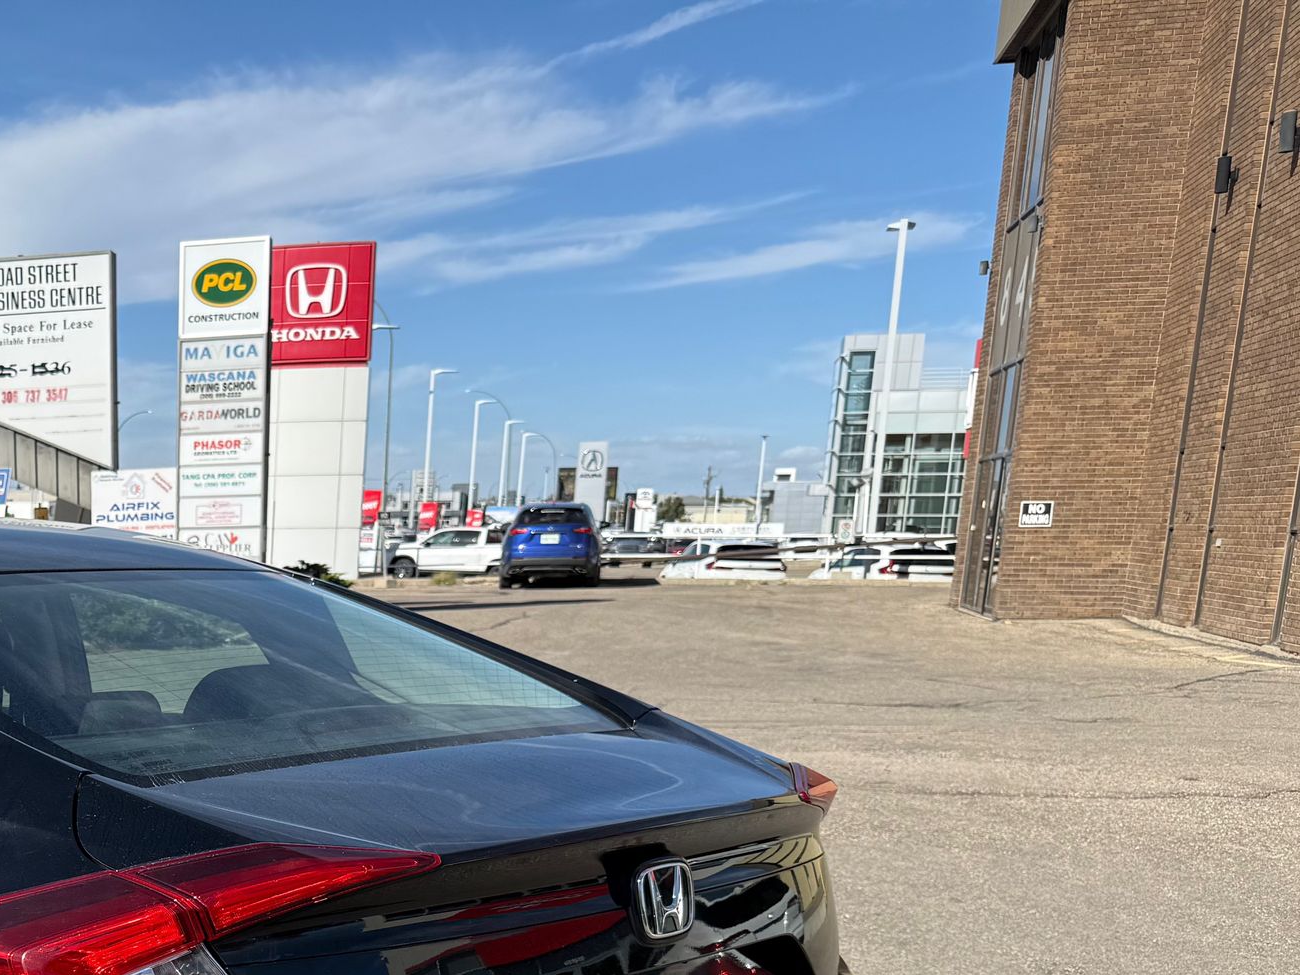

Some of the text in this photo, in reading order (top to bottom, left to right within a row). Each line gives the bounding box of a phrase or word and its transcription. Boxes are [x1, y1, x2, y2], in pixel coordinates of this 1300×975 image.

[28, 263, 78, 285] STREET
[201, 271, 247, 293] PCL
[50, 285, 103, 308] CENTRE
[188, 311, 259, 324] CONSTRUCTION
[3, 322, 34, 336] Space
[39, 320, 58, 332] For
[63, 319, 94, 330] Lease
[27, 335, 65, 345] Furnished
[271, 326, 360, 343] HONDA
[186, 371, 257, 383] WASCANA
[185, 381, 257, 394] DRIVING SCHOOL
[25, 389, 41, 403] 737
[180, 407, 261, 422] GARDAWORLD
[194, 439, 241, 450] PHASOR
[109, 501, 160, 512] AIRFIX
[1028, 503, 1046, 514] NO
[96, 512, 175, 523] PLUMBING
[1022, 513, 1050, 525] PARKING
[684, 527, 724, 535] ACURA
